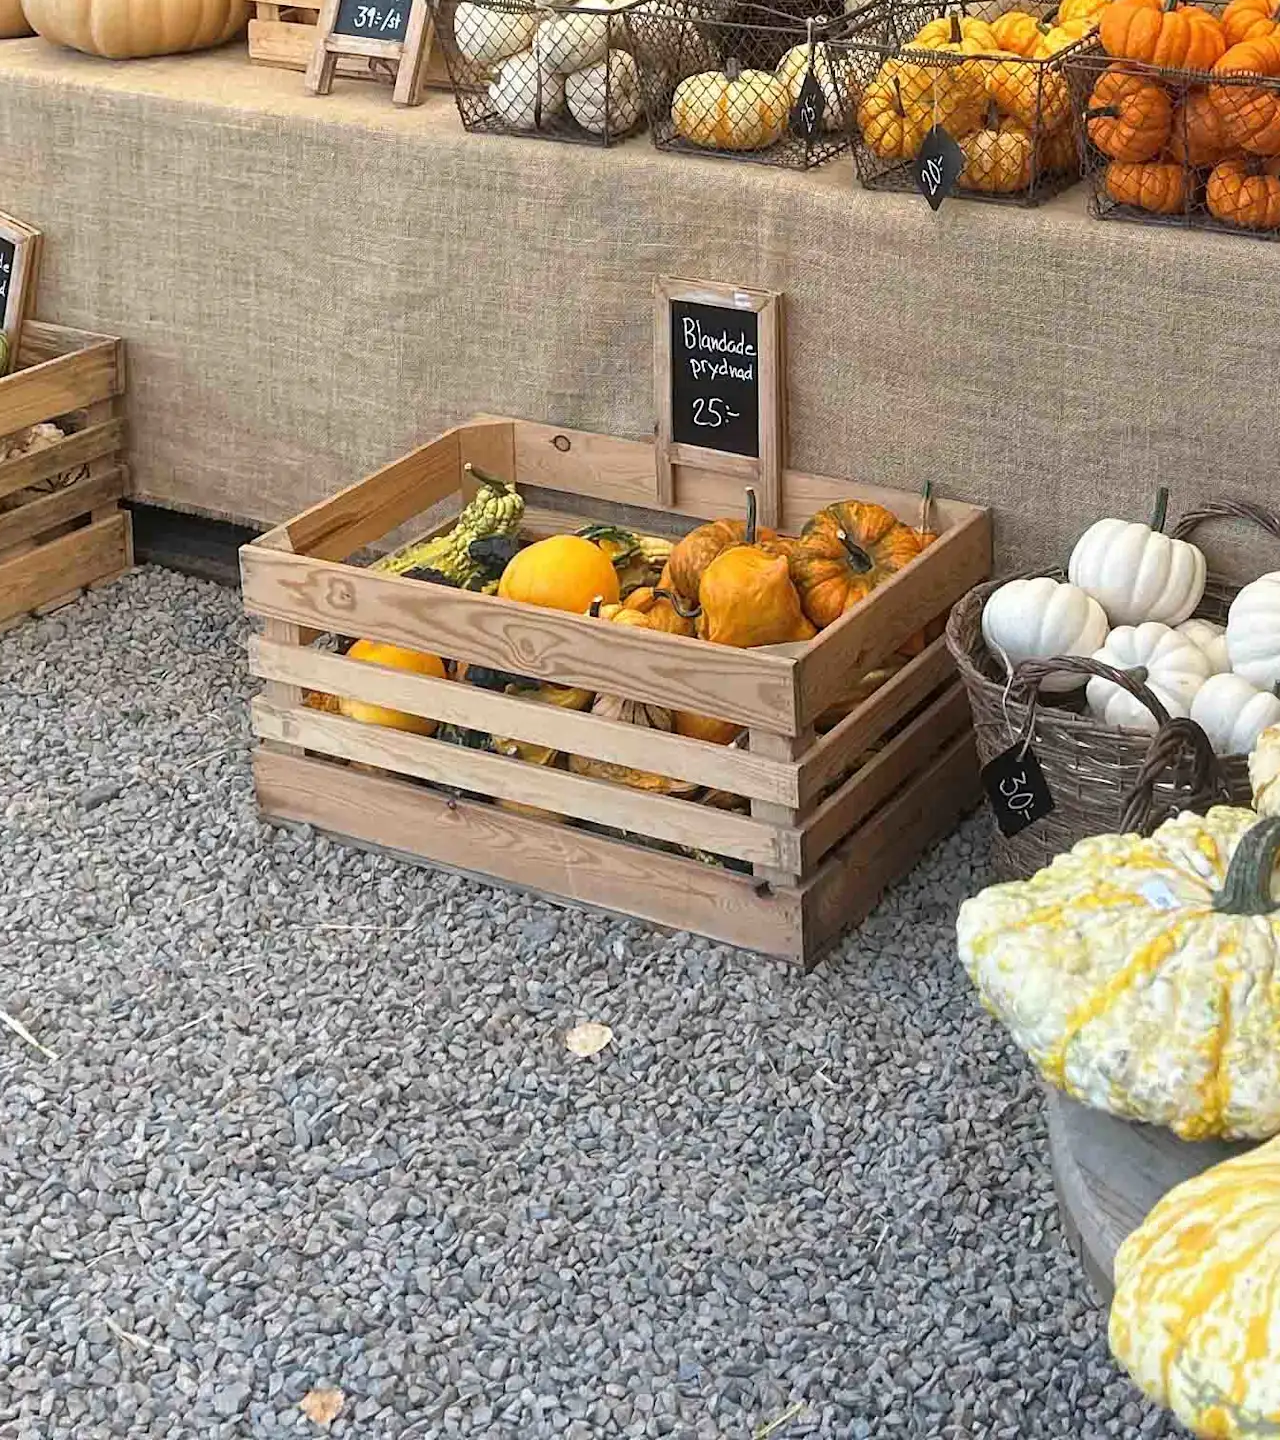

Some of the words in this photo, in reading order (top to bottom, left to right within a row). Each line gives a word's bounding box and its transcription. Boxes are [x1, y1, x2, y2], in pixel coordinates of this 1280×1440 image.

[921, 155, 944, 196] 20:-
[682, 316, 757, 356] Blandade
[690, 358, 753, 381] prydnad
[692, 398, 740, 427] 25:-
[999, 770, 1034, 821] 30:-
